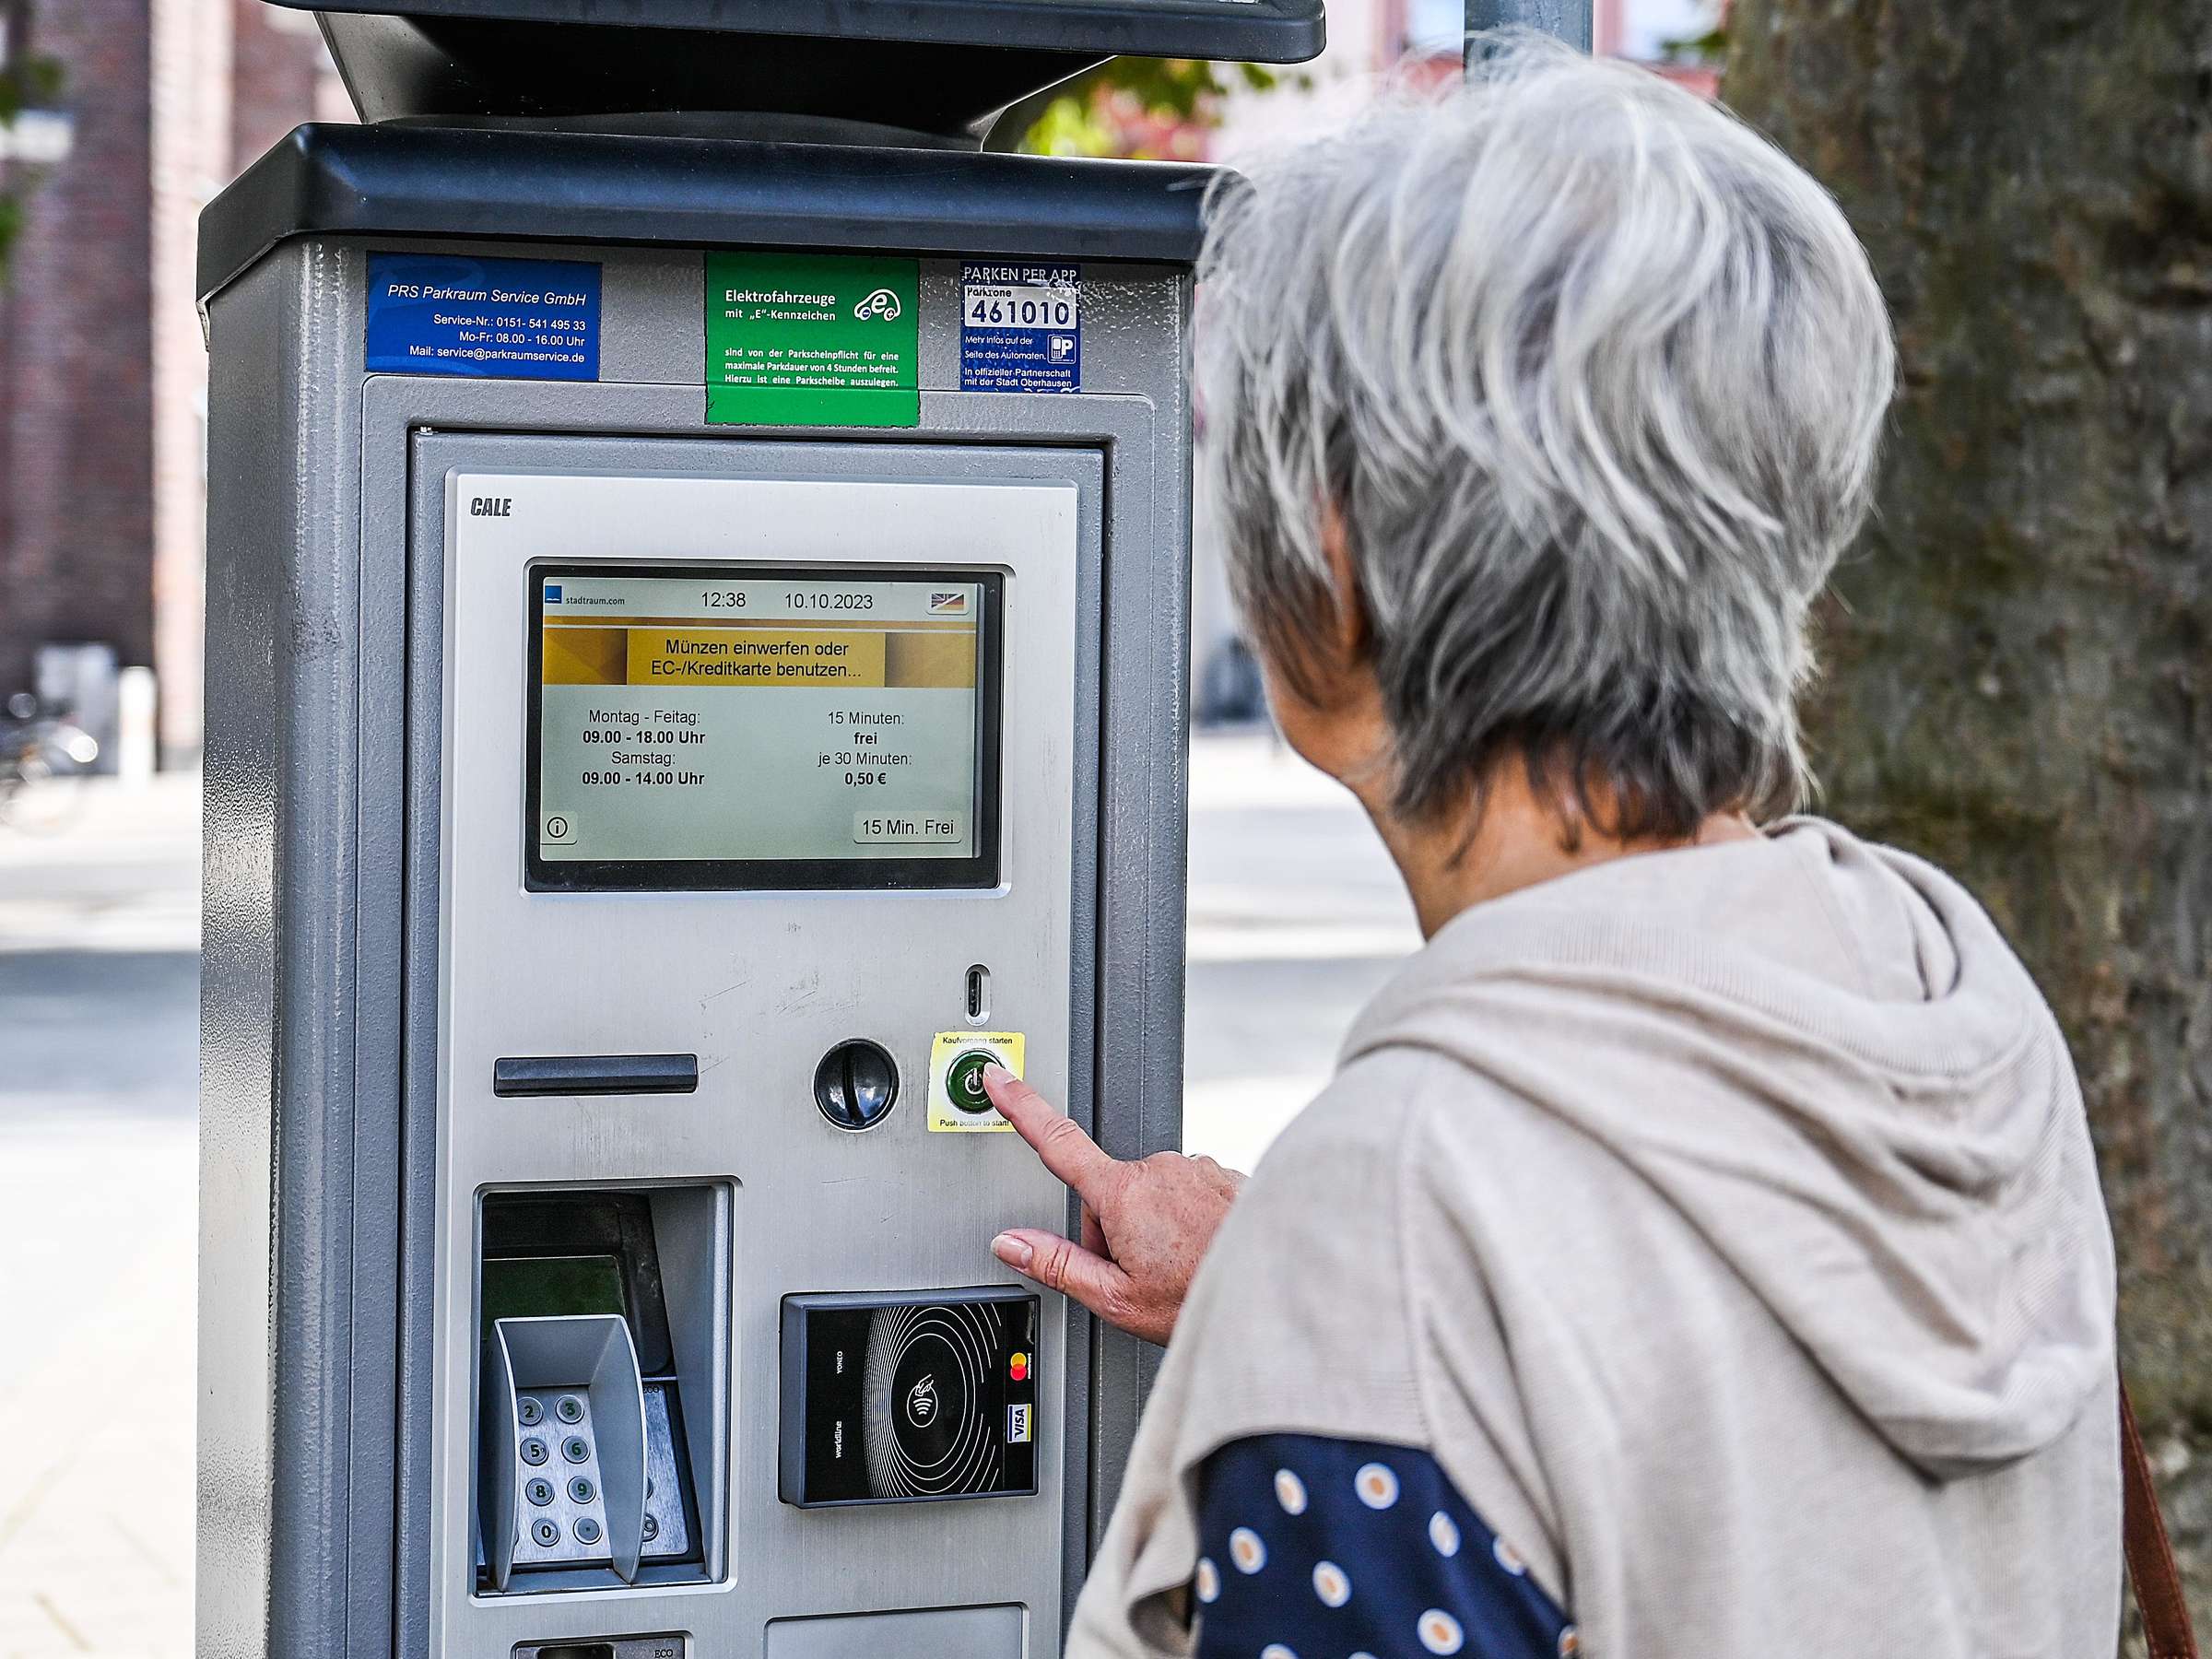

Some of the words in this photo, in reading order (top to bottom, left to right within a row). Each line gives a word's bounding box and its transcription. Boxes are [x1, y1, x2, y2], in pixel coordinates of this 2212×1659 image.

[964, 266, 1018, 281] PARKEN
[1023, 269, 1046, 280] PER
[1051, 269, 1077, 281] APP
[388, 284, 418, 298] PRS
[423, 286, 487, 301] Parkraum
[491, 289, 539, 304] Service
[544, 292, 586, 306] GmbH
[725, 289, 836, 307] Elektrofahrzeuge
[967, 287, 1012, 298] Parkzone
[725, 309, 743, 318] mit
[971, 300, 1069, 324] 461010
[433, 314, 494, 326] Service-Nr.:
[496, 317, 526, 327] 0151-
[529, 319, 547, 329] 541
[551, 320, 570, 330] 495
[573, 321, 586, 331] 33
[459, 331, 493, 343] Mo-Fr:
[496, 333, 525, 344] 08.00
[535, 335, 563, 346] 16.00
[566, 335, 585, 347] Uhr
[965, 336, 984, 345] Mehr
[986, 335, 1004, 345] Infos
[1006, 336, 1018, 345] auf
[1019, 336, 1032, 345] der
[409, 345, 434, 357] Mail:
[437, 347, 585, 363] service@parkraumservice.de
[724, 347, 743, 358] sind
[769, 348, 783, 359] der
[788, 349, 859, 360] Parkscheinpflicht
[864, 350, 876, 360] für
[881, 352, 900, 361] eine
[964, 350, 984, 359] Seite
[985, 351, 999, 359] des
[1001, 352, 1046, 360] Automaten.
[724, 361, 765, 371] maximale
[767, 362, 808, 371] Parkdauer
[827, 364, 831, 372] 4
[833, 363, 867, 373] Stunden
[869, 364, 899, 374] befreit.
[965, 368, 973, 376] In
[974, 367, 1012, 377] offizieller
[1015, 369, 1071, 378] Partnerschaft
[724, 374, 752, 383] Hierzu
[757, 375, 768, 383] ist
[772, 375, 791, 384] eine
[795, 376, 845, 386] Parkscheibe
[850, 378, 899, 388] auszulegen.
[980, 378, 994, 386] der
[995, 378, 1018, 386] Stadt
[1020, 379, 1072, 387] Oberhausen
[470, 497, 512, 517] CALE
[565, 596, 625, 606] stadtraum.com
[701, 592, 746, 607] 12:38
[784, 593, 873, 609] 10.10.2023
[665, 639, 728, 655] Münzen
[733, 640, 809, 655] einwerfen
[815, 641, 849, 655] oder
[652, 660, 771, 676] EC-/Kreditkarte
[776, 662, 862, 677] benutzen...
[589, 710, 640, 725] Montag
[653, 710, 700, 726] Feitag:
[828, 712, 844, 724] 15
[849, 712, 905, 724] Minuten:
[582, 731, 621, 744] 09.00
[637, 731, 674, 744] 18.00
[678, 731, 706, 744] Uhr
[854, 732, 877, 745] frei
[611, 751, 676, 767] Samstag:
[818, 752, 830, 768] je
[835, 752, 852, 765] 30
[856, 752, 912, 765] Minuten:
[582, 771, 621, 785] 09.00
[635, 772, 673, 785] 14.00
[678, 772, 705, 785] Uhr
[844, 772, 874, 787] 0,50
[877, 772, 887, 785] €
[863, 819, 881, 835] 15
[887, 819, 919, 835] Min.
[925, 820, 954, 834] Frei
[940, 1119, 958, 1127] Push
[524, 1405, 535, 1418] 2
[564, 1403, 575, 1416] 3
[1015, 1408, 1026, 1439] VISA
[531, 1444, 540, 1457] 5
[571, 1442, 582, 1456] 6
[535, 1485, 546, 1498] 8
[577, 1482, 588, 1496] 9
[654, 1649, 674, 1658] ECO
